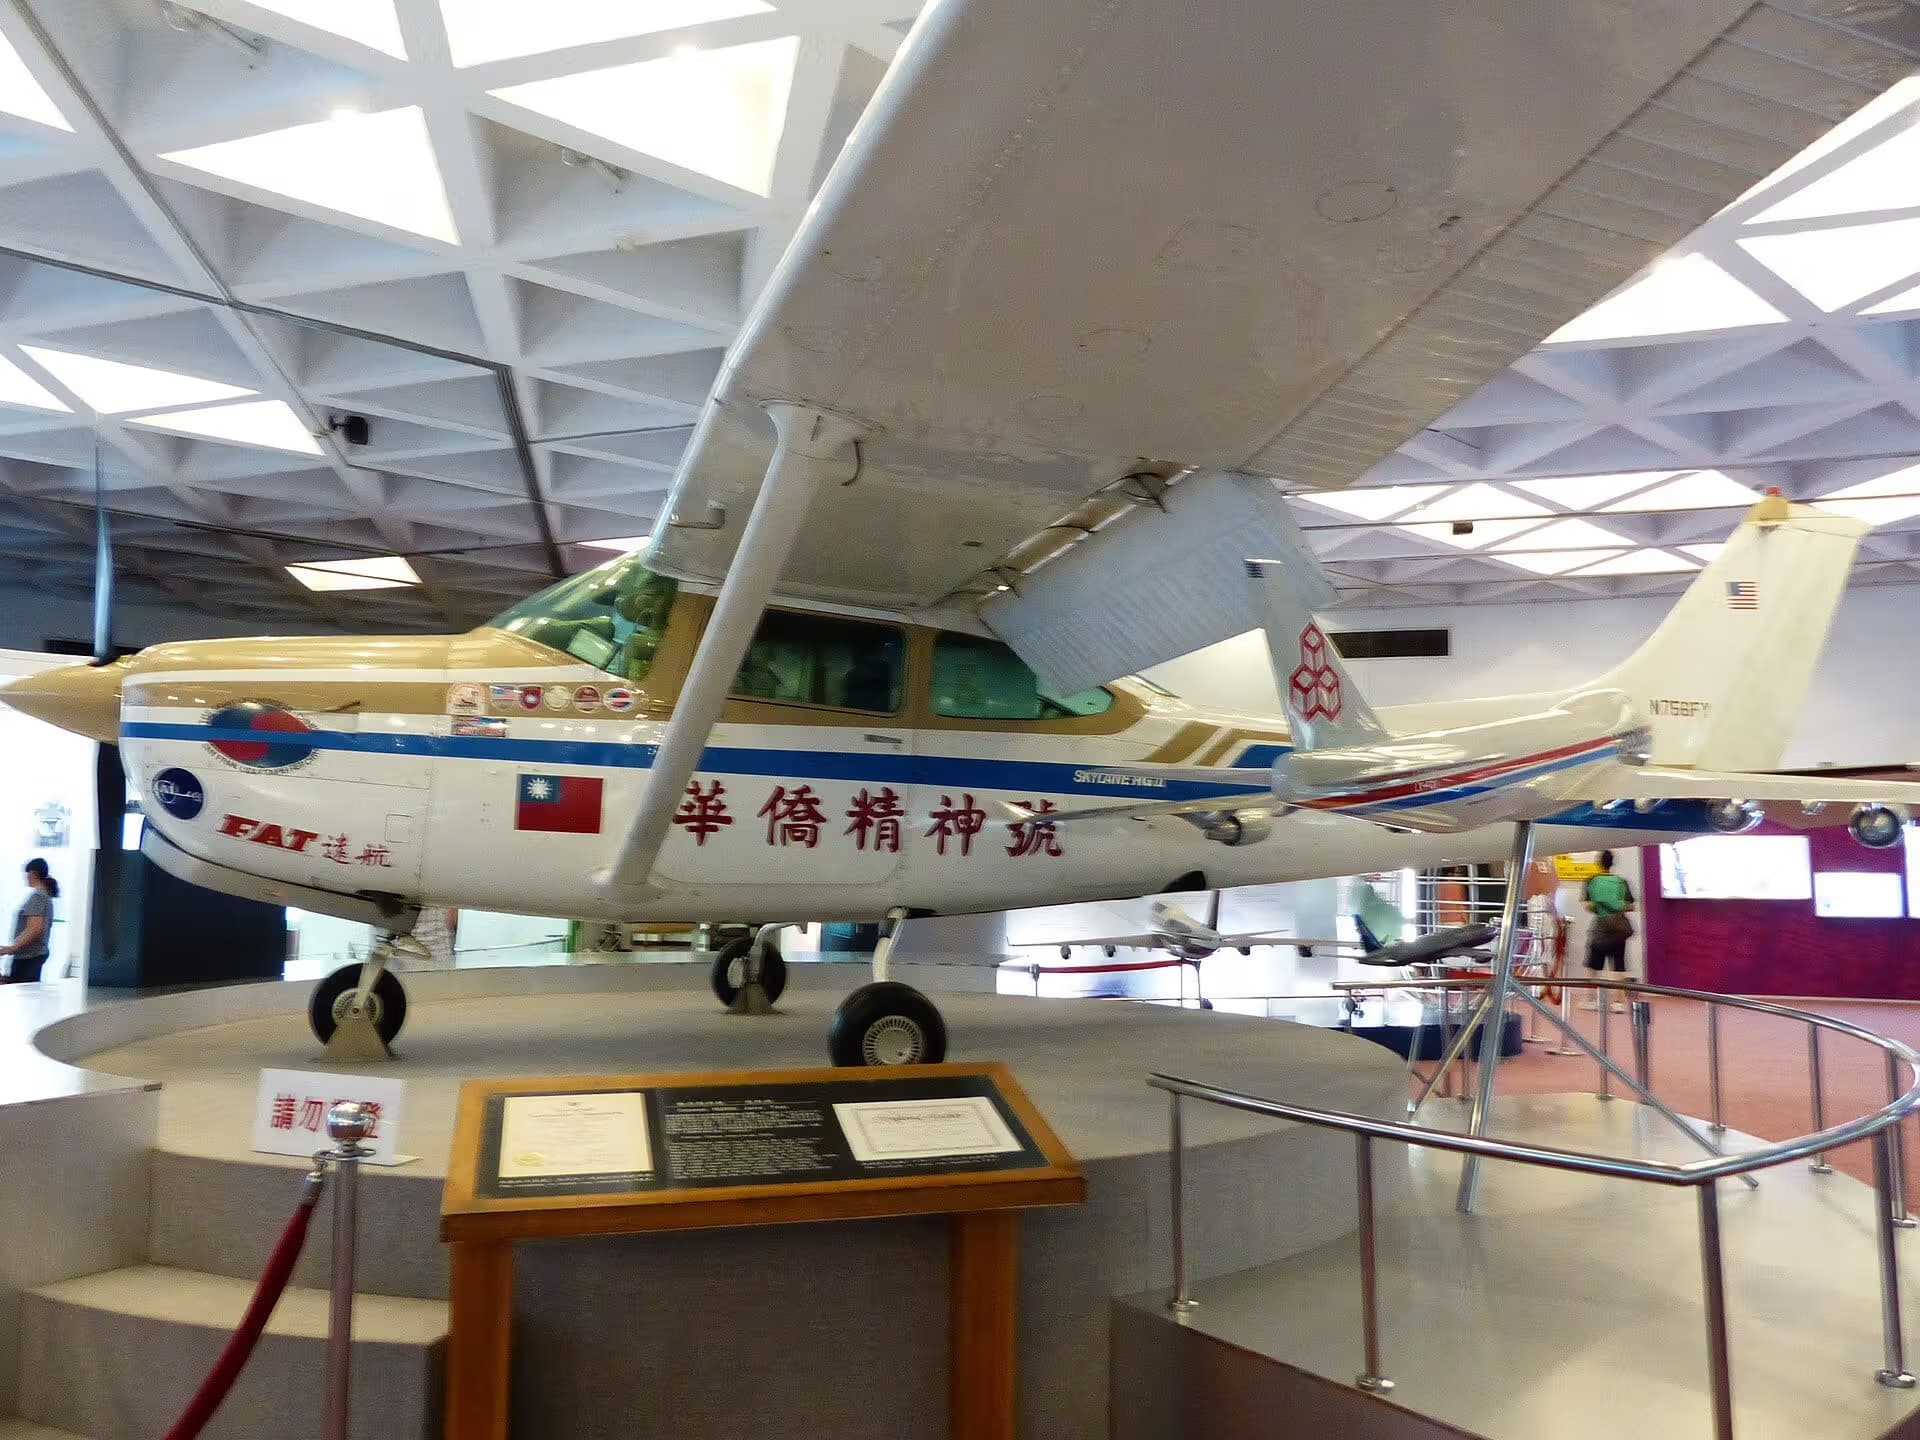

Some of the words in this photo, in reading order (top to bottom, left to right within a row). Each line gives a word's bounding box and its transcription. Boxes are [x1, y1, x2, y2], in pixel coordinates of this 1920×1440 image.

[1073, 769, 1130, 786] SKYLANE
[217, 814, 319, 852] FAT
[673, 779, 1065, 858] 華僑精神號
[270, 1094, 384, 1139] 請勿登
